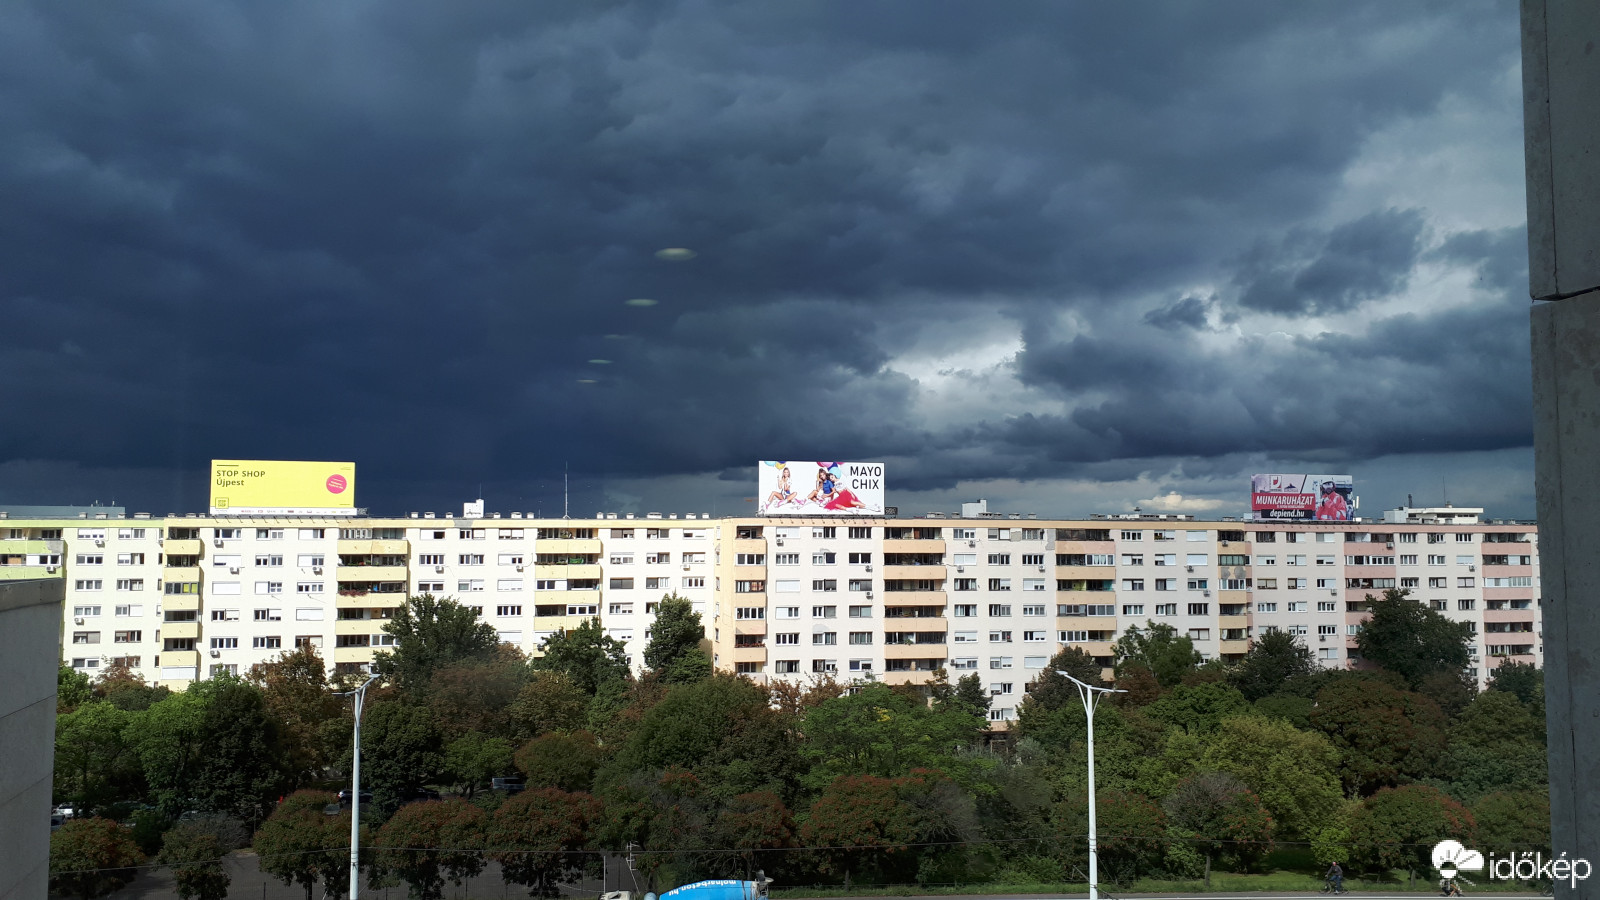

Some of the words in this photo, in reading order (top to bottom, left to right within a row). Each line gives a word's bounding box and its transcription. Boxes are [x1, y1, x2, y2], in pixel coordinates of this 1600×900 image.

[850, 466, 882, 477] MAYO
[216, 477, 245, 487] Újpest
[852, 479, 880, 490] CHIX
[1255, 494, 1314, 505] MUNKARUHÁZAT
[1269, 509, 1305, 519] depiend.hu
[668, 880, 737, 896] molnarbeton.hu
